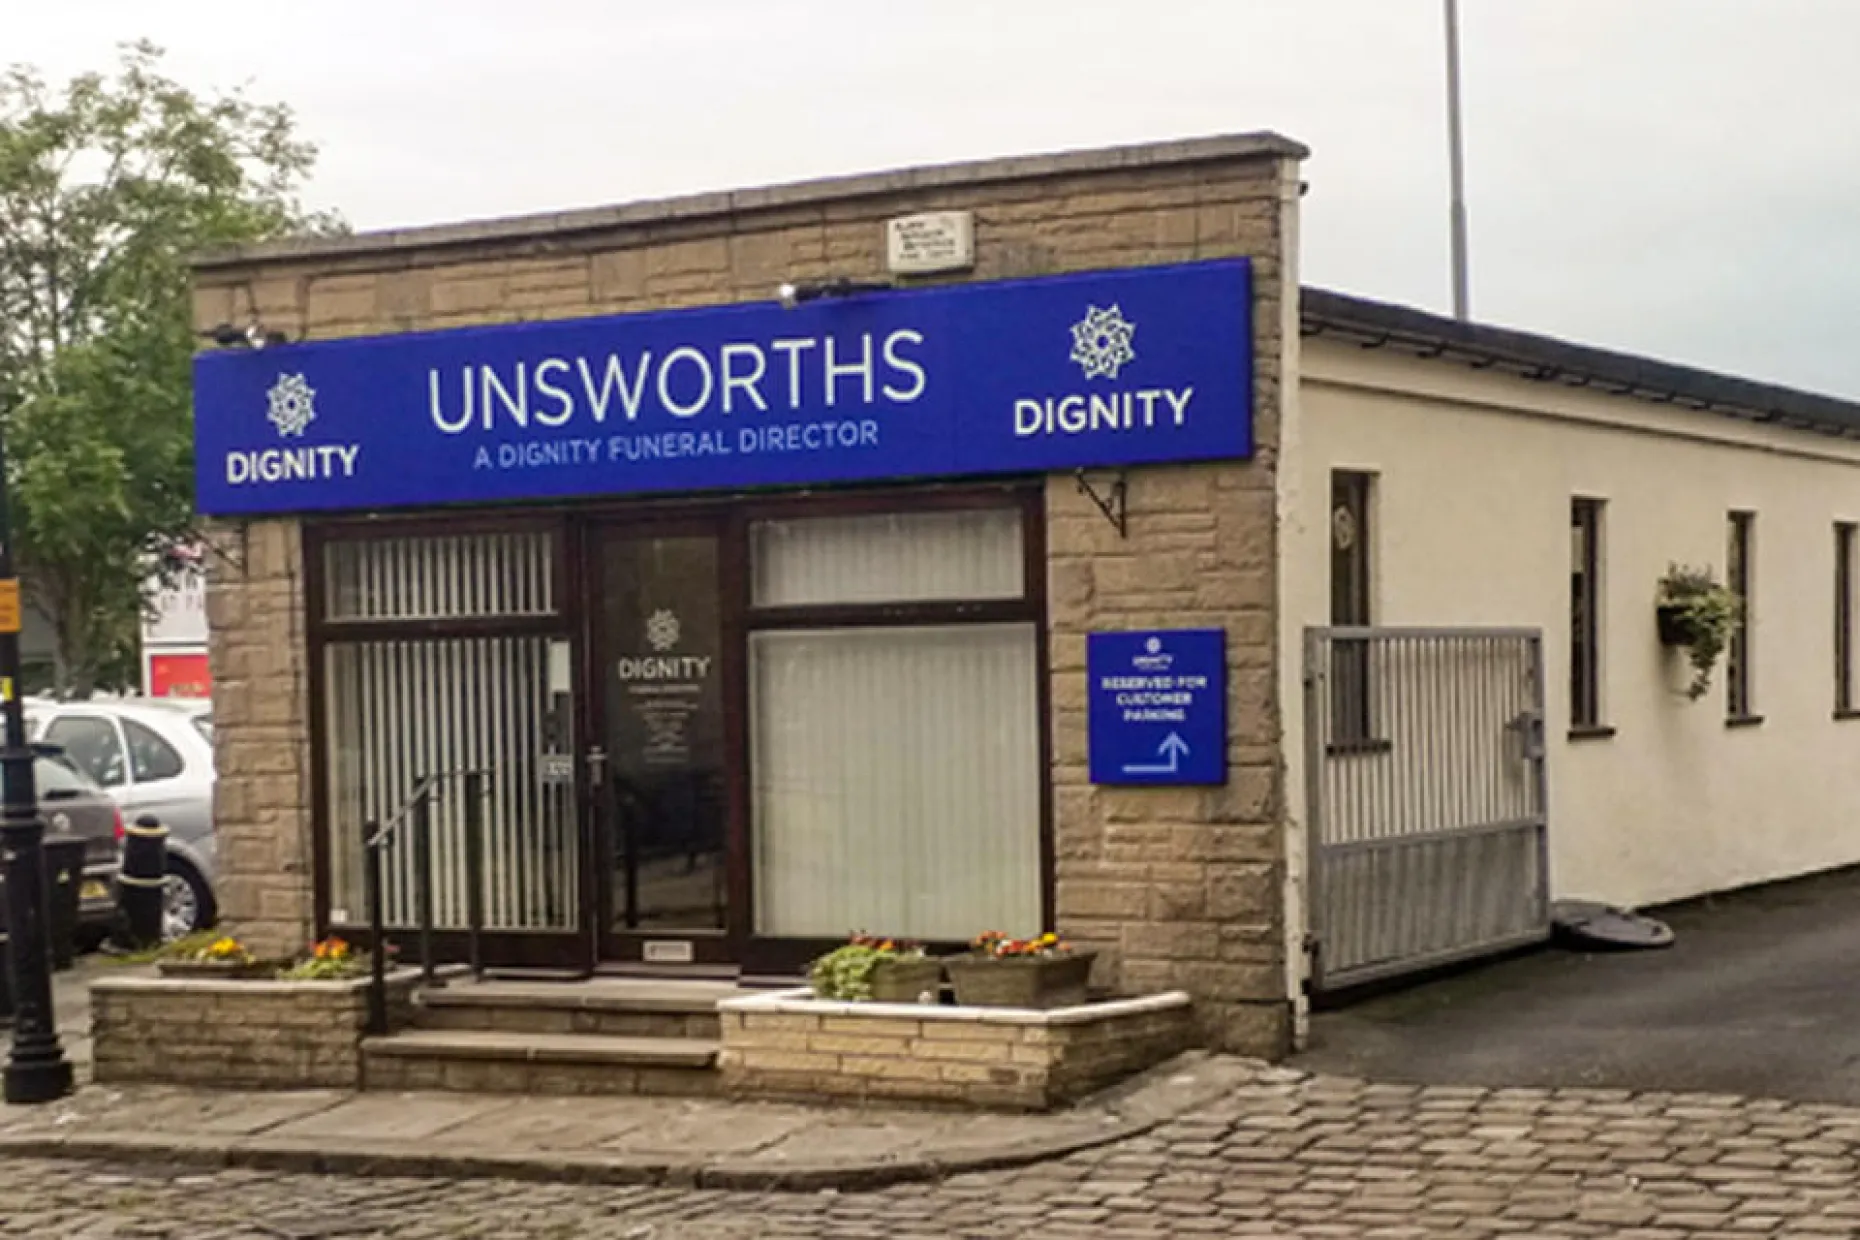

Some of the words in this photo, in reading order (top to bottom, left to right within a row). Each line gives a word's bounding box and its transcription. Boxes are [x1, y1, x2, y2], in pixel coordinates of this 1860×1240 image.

[428, 328, 927, 433] UNSWORTHS
[1013, 386, 1194, 437] DIGNITY
[473, 444, 494, 470] A
[498, 437, 601, 469] DIGNITY
[607, 429, 732, 461] FUNERAL
[738, 419, 879, 453] DIRECTOR
[226, 443, 360, 485] DIGNITY
[618, 655, 712, 679] DIGNITY
[1101, 675, 1173, 690] RESERVED
[1177, 674, 1208, 690] FOR
[1115, 691, 1193, 706] CUSTOMER
[1123, 707, 1187, 722] PARKING
